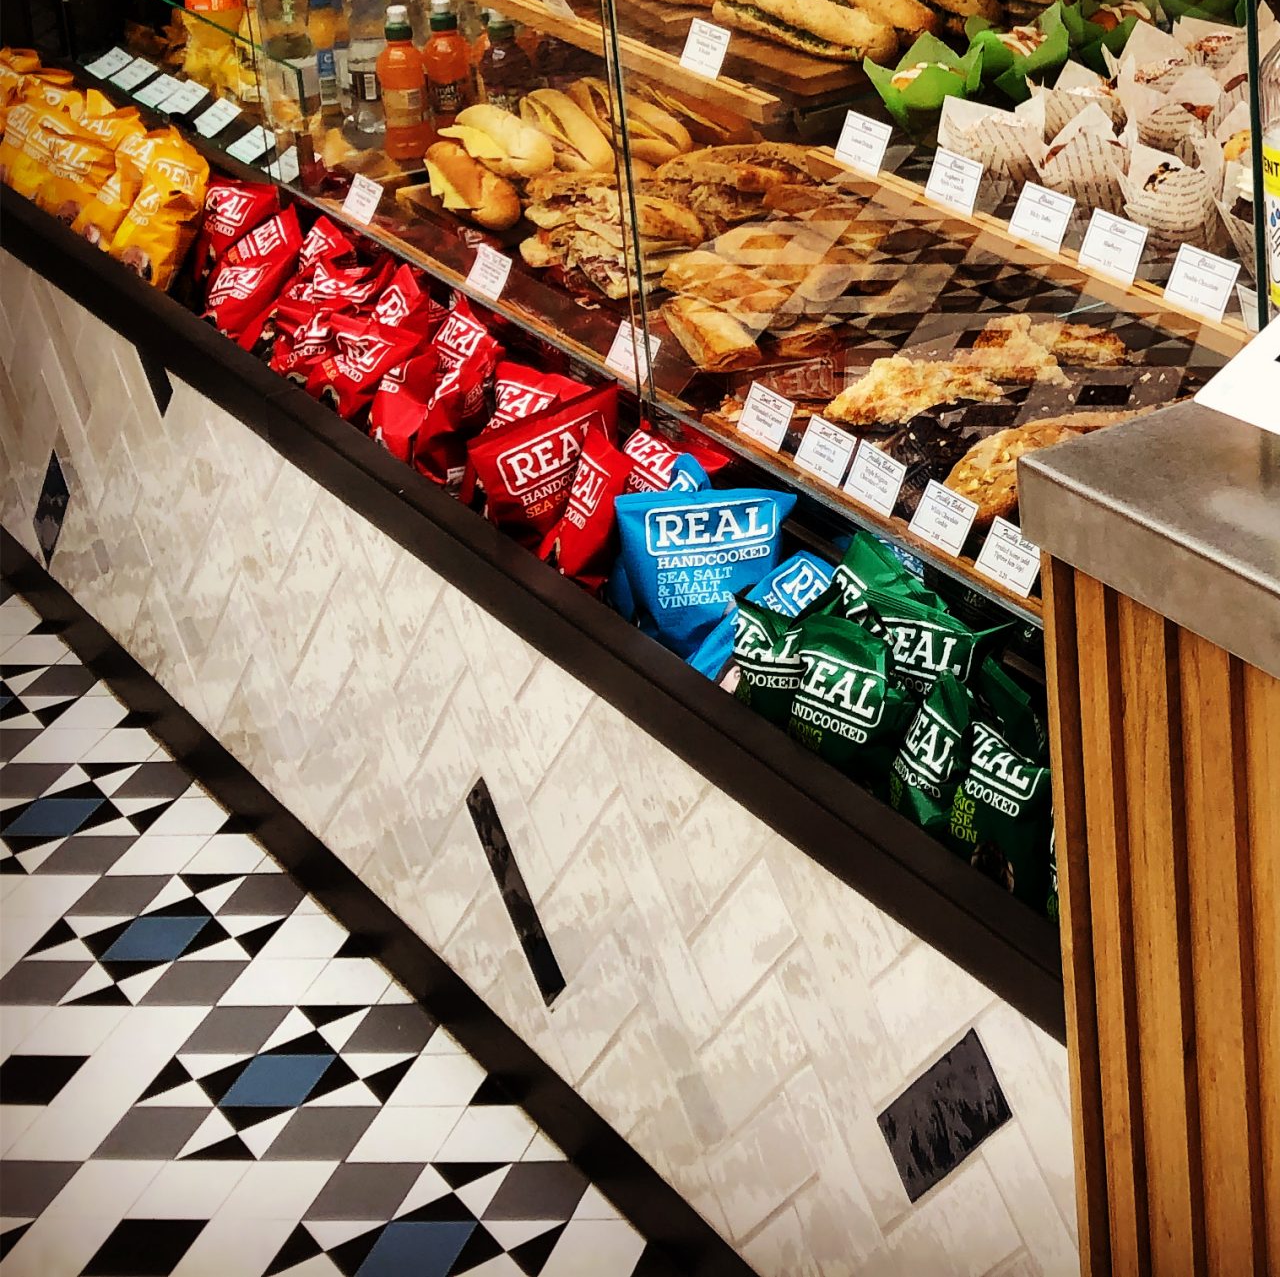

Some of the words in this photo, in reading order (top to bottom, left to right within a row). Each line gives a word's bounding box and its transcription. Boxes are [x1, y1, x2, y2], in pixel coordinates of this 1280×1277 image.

[572, 461, 604, 510] EAL
[951, 499, 966, 513] Baked
[655, 507, 769, 548] REAL
[657, 544, 771, 569] HANDCOOKED
[657, 571, 689, 585] SEA
[693, 566, 733, 581] SALT
[658, 585, 670, 597] &
[674, 579, 720, 595] MALT
[658, 591, 734, 609] VINEGAR
[891, 626, 961, 677] EAL
[905, 713, 956, 775] EAL
